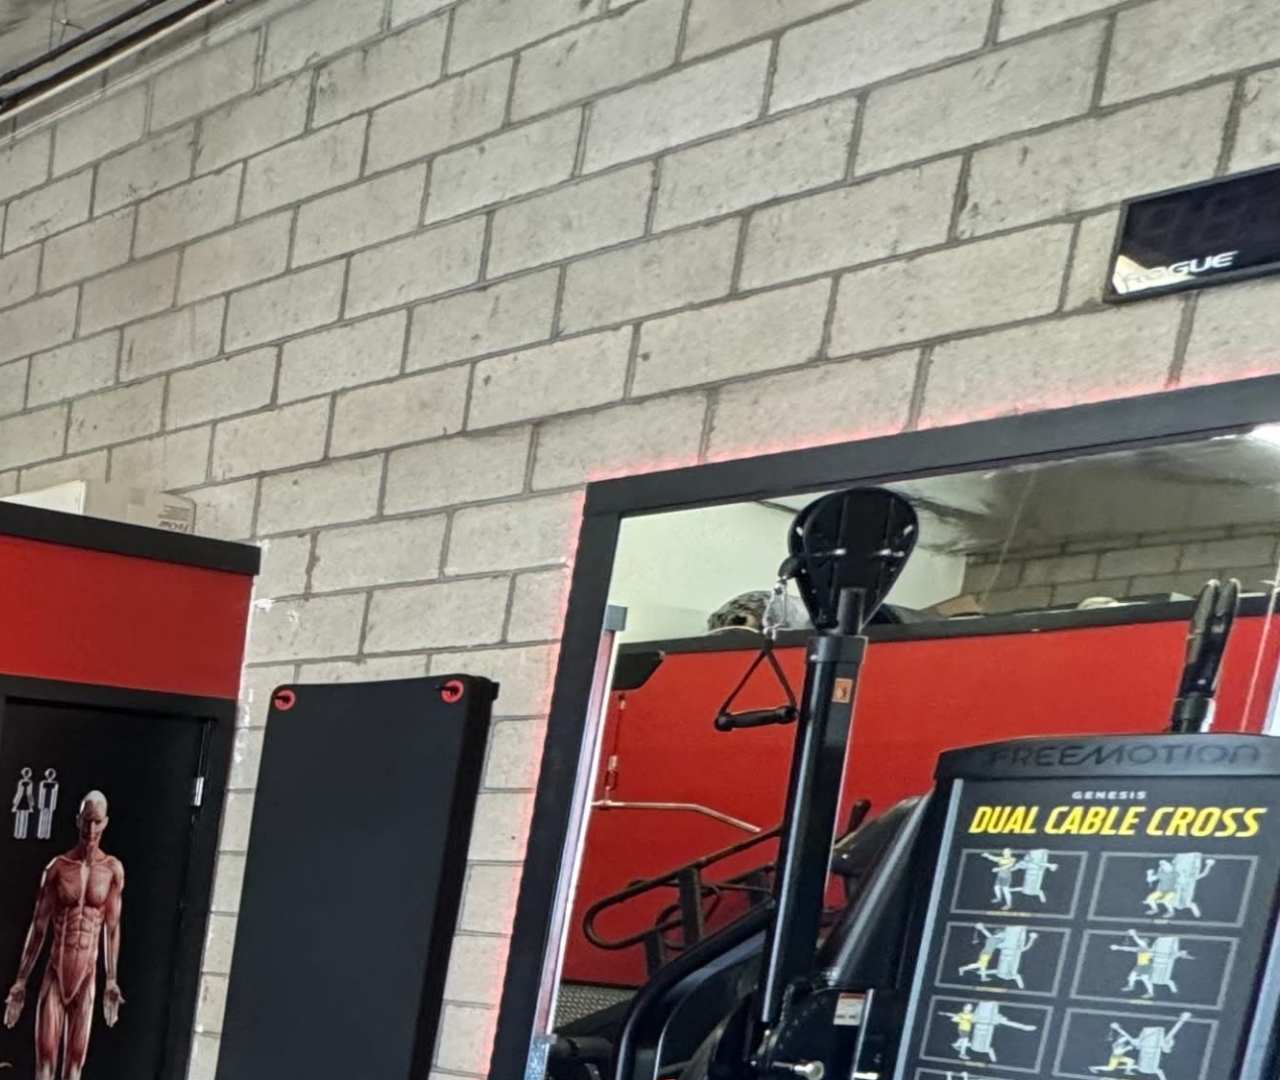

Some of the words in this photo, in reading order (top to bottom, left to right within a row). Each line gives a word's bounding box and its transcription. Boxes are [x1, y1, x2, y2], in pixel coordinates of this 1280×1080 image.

[992, 743, 1260, 767] FREEMOTION
[1072, 790, 1147, 800] GENESIS
[968, 806, 1039, 834] DUAL
[1044, 806, 1147, 836] CABLE
[1146, 807, 1268, 838] CROSS
